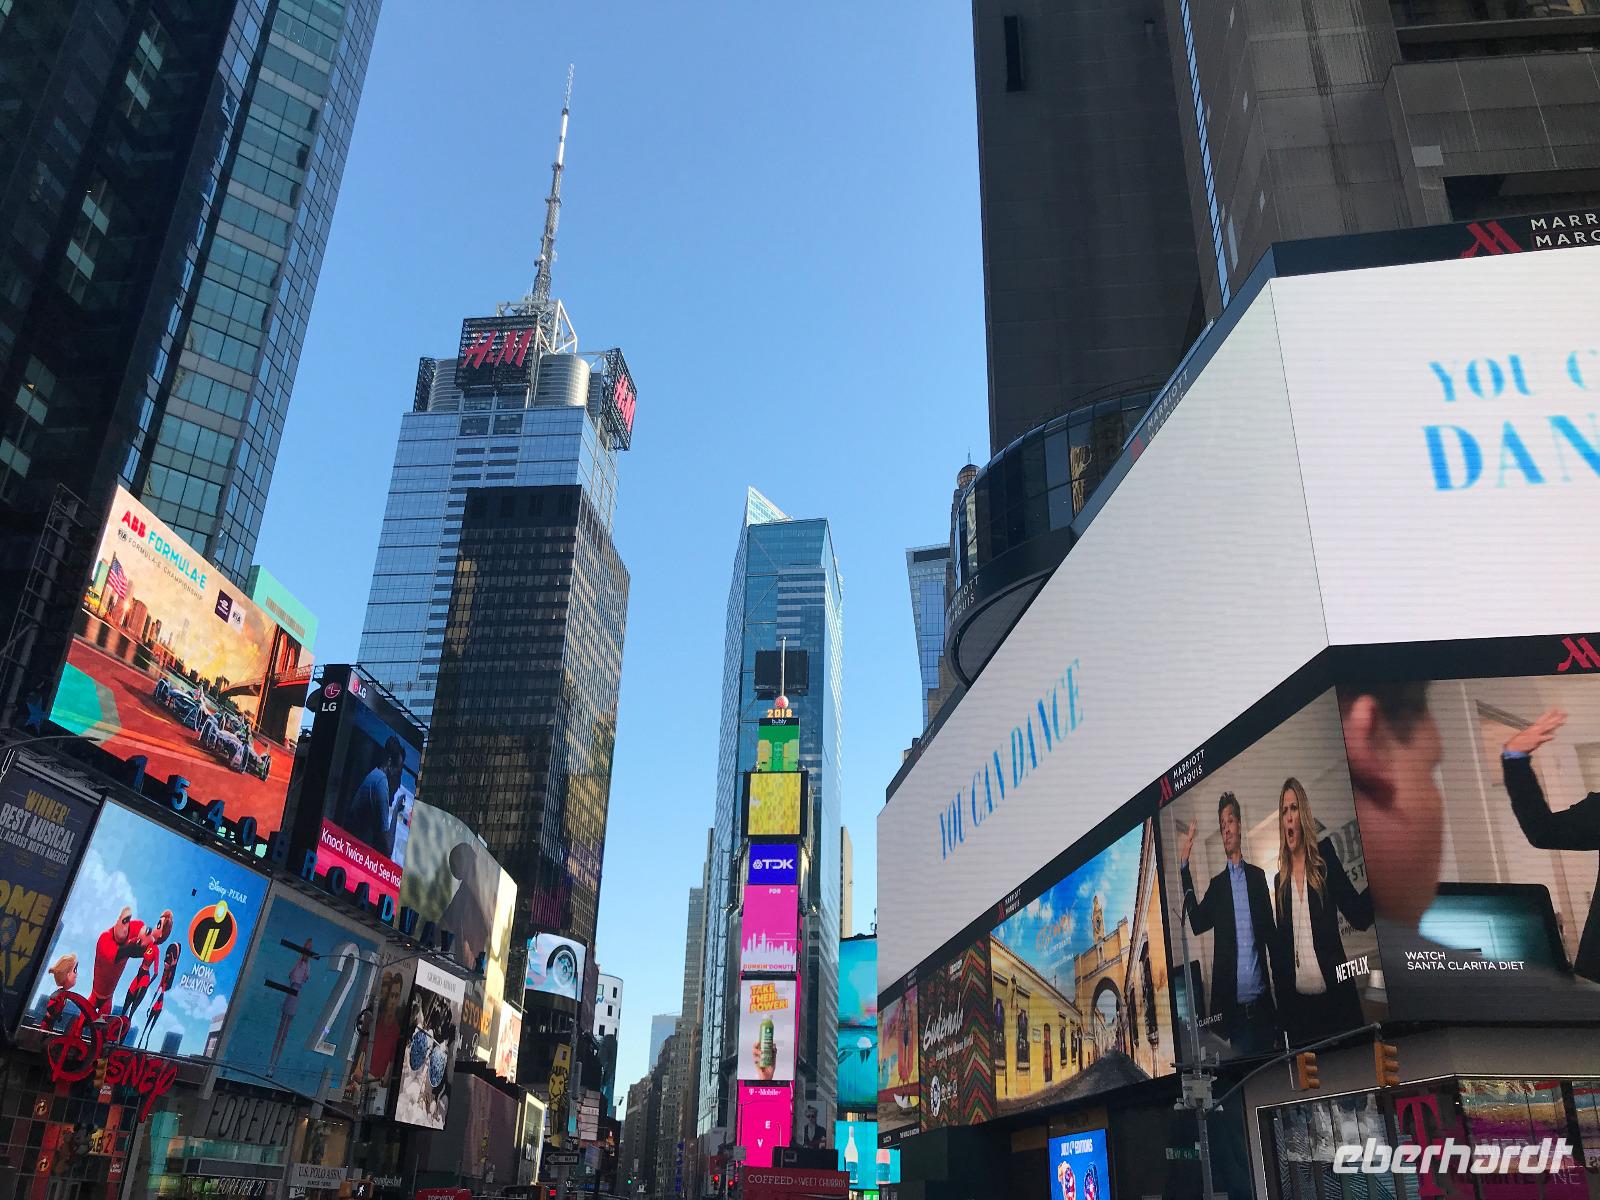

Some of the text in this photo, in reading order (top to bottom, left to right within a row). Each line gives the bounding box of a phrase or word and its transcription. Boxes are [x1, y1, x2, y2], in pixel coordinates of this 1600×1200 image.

[459, 328, 534, 370] H&M
[1428, 352, 1536, 403] YOU
[1147, 368, 1188, 431] MARRIOTT
[121, 510, 146, 539] ABB
[321, 702, 338, 712] LG
[767, 708, 793, 718] 2018
[1009, 657, 1084, 789] DANCE
[1173, 749, 1205, 779] MARRIOTT
[1174, 764, 1203, 792] MARQUIS
[0, 802, 76, 855] BEST MUSICAL
[4, 830, 29, 849] ACROSS
[45, 846, 70, 866] AMERICA
[321, 828, 344, 853] Knock
[345, 842, 364, 867] Twice
[364, 854, 379, 874] And
[378, 863, 391, 882] See
[761, 859, 794, 870] TDK
[208, 875, 248, 905] Disney PIXAR
[1335, 955, 1370, 984] NETFLIX
[1405, 951, 1446, 960] WATCH
[1407, 961, 1525, 970] SANTA CLARITA DIET
[191, 963, 214, 979] NOW
[179, 976, 215, 996] PLAYING
[751, 983, 775, 996] TAKE
[463, 1000, 490, 1036] STONE
[750, 999, 788, 1014] POWER!
[204, 1093, 297, 1146] FOREVER
[218, 1177, 266, 1197] FOREVER 21
[748, 1174, 794, 1185] COFFEED
[798, 1177, 817, 1187] SWEET
